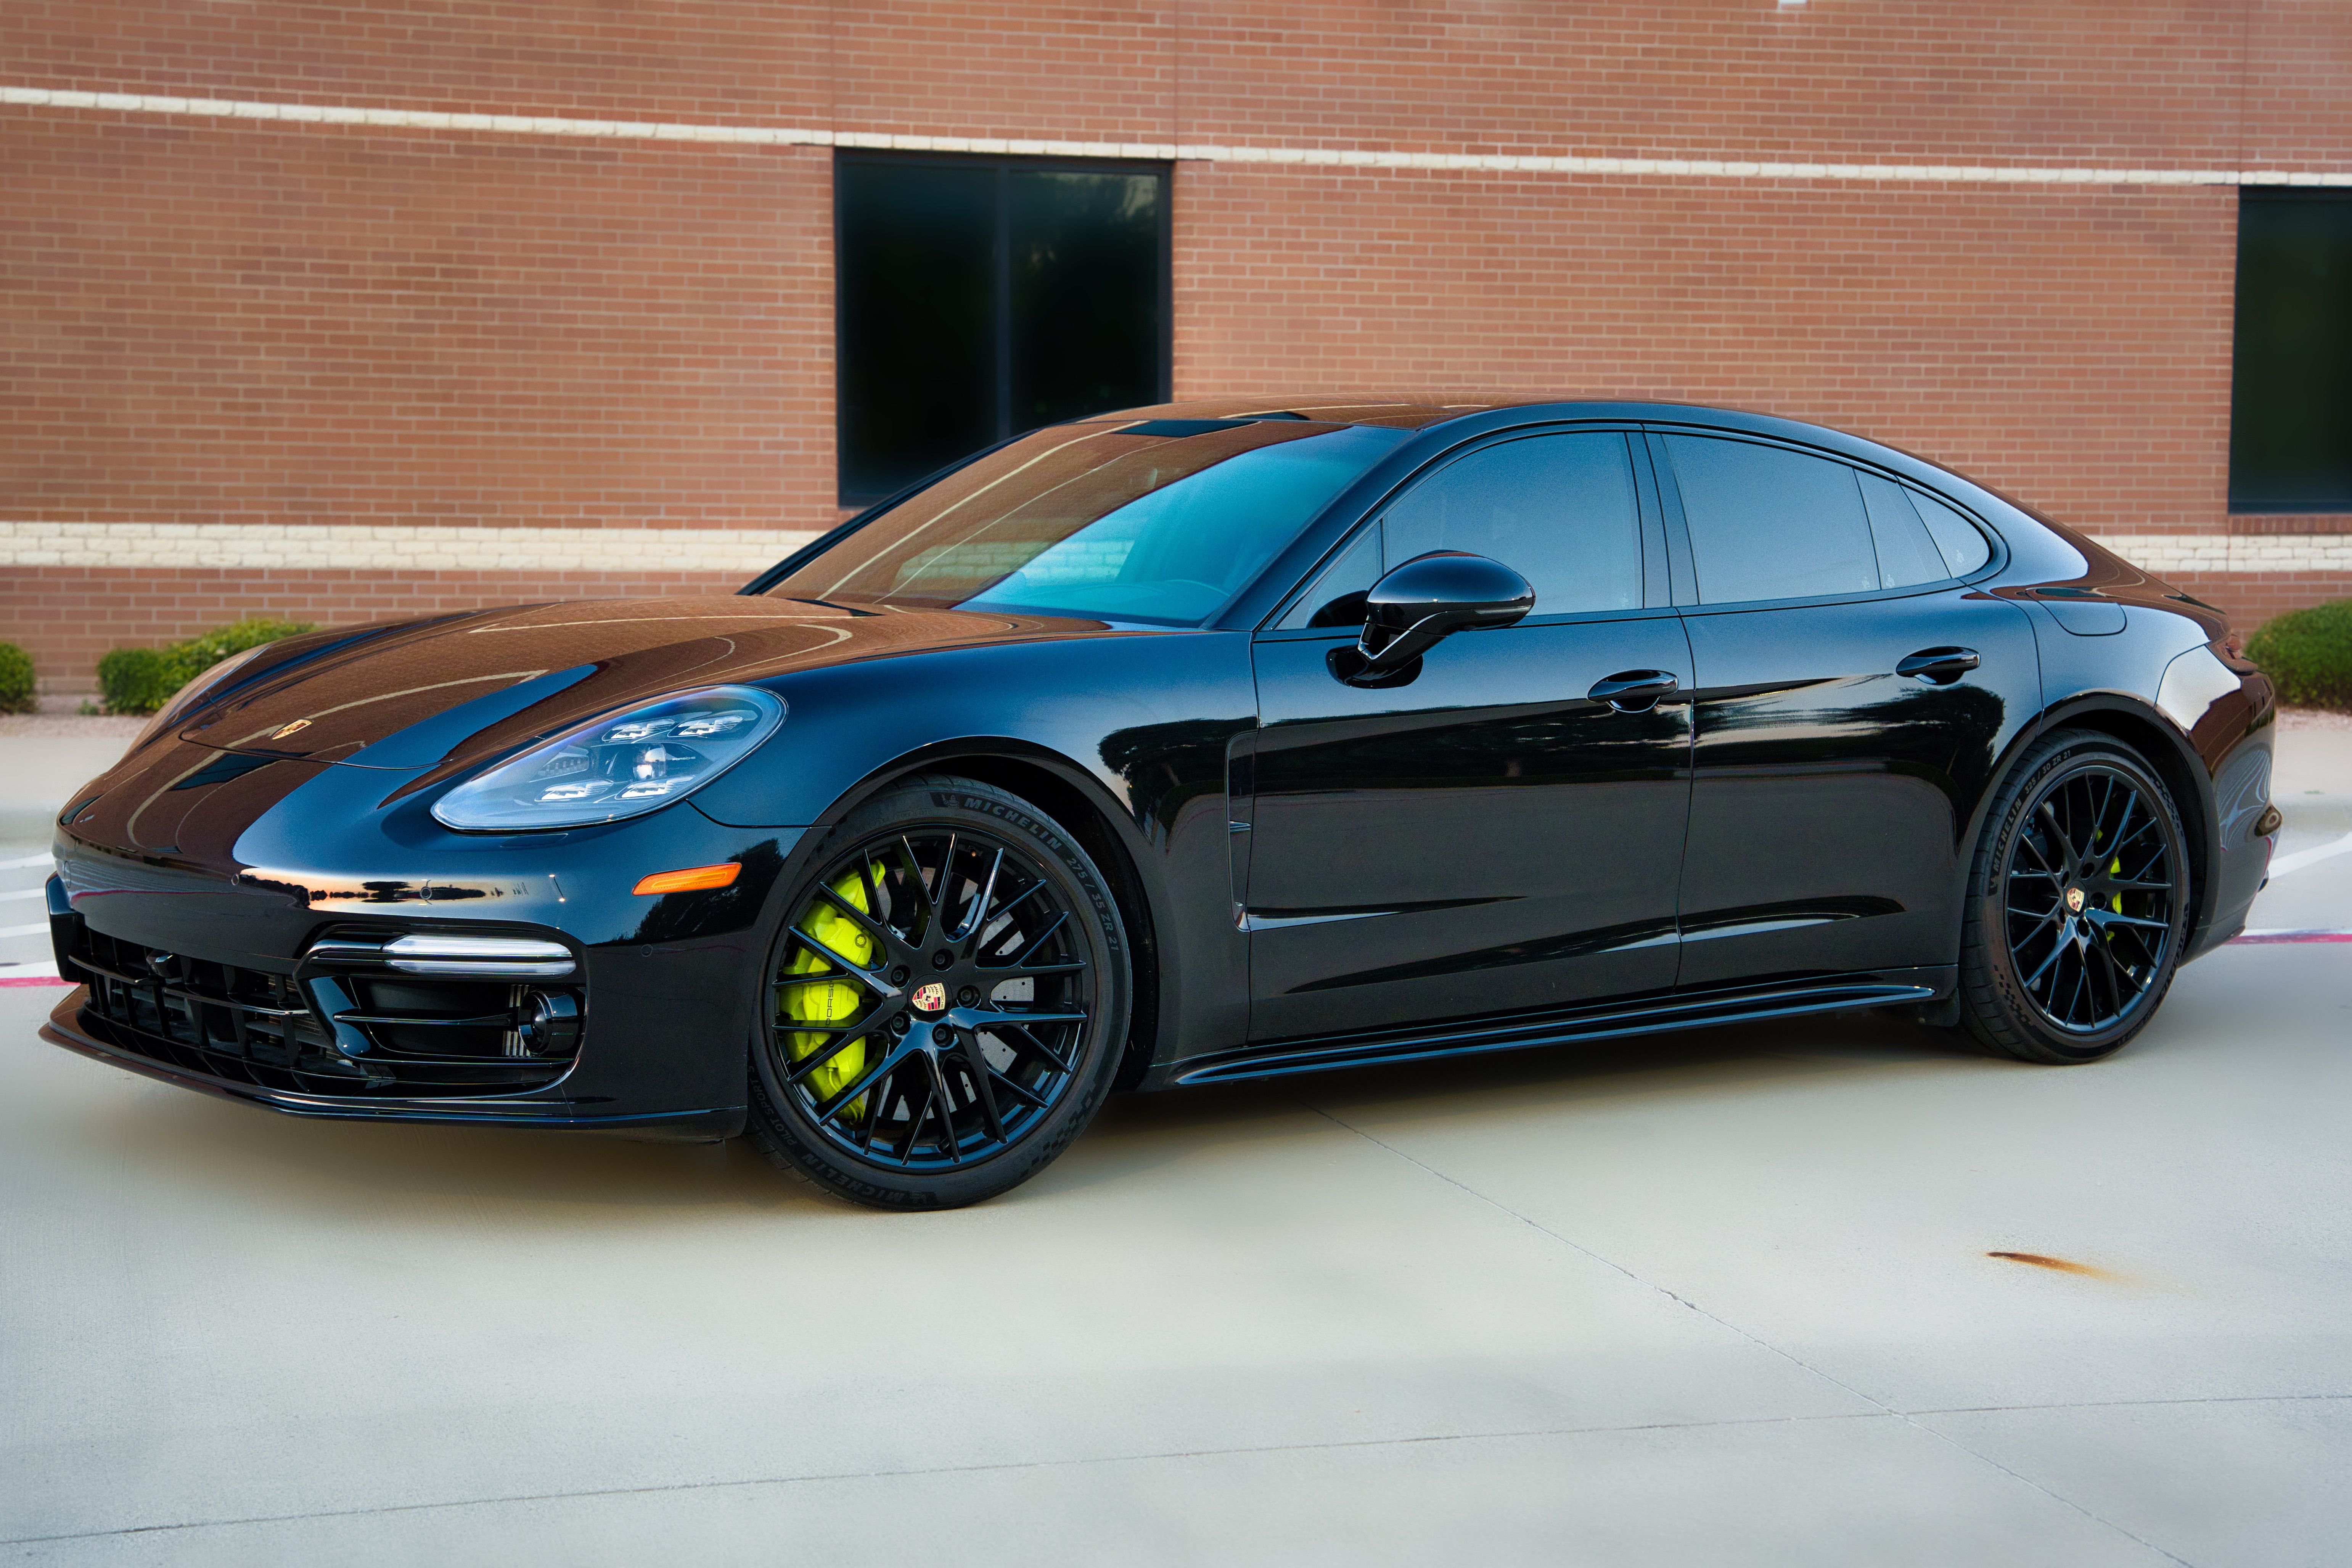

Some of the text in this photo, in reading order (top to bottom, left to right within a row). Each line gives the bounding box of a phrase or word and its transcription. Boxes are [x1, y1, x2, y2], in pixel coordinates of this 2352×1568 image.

[1993, 798, 2022, 873] MICHELIN
[2025, 778, 2036, 794] 325
[2042, 763, 2051, 774] 30
[2052, 754, 2062, 766] ZR
[2063, 749, 2071, 759] 21
[964, 798, 1062, 850] MICHELIN
[1066, 858, 1088, 878] 275
[1092, 893, 1105, 909] 35
[1101, 913, 1114, 931] ZR
[1108, 936, 1119, 951] 21
[750, 1077, 774, 1115] SPORT
[770, 1118, 797, 1145] PILOT
[802, 1153, 905, 1203] MICHELIN
